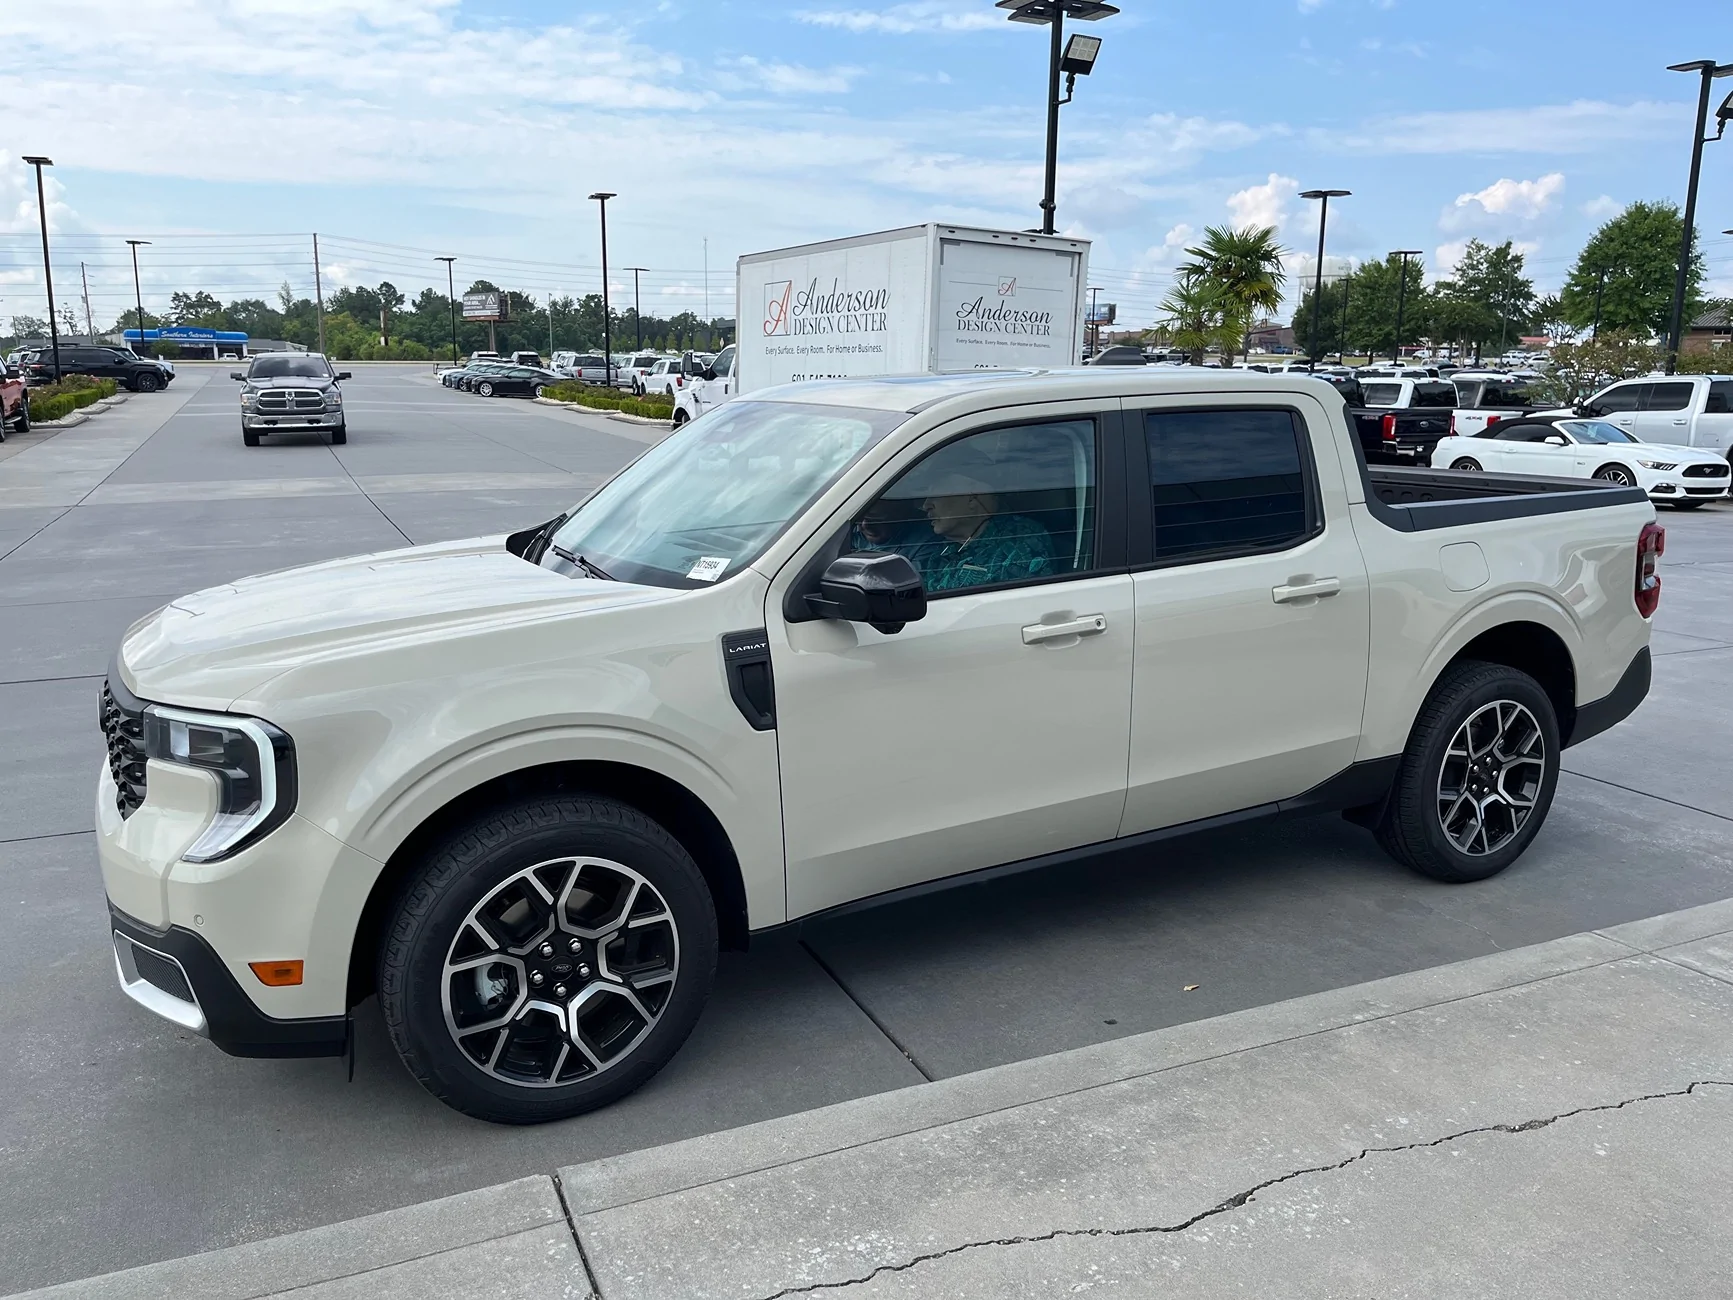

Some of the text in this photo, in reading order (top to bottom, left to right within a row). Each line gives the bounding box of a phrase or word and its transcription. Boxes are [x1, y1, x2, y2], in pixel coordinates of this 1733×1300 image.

[792, 277, 891, 316] Anderson
[956, 296, 1054, 324] Anderson
[794, 312, 887, 335] DESIGN CENTER
[957, 319, 1050, 336] DESIGN CENTER
[765, 346, 777, 356] Every
[778, 345, 795, 354] Surface.
[797, 345, 809, 356] Every
[810, 345, 825, 354] Room.
[827, 344, 835, 353] For
[835, 344, 850, 353] Home
[858, 343, 883, 353] Business.
[729, 643, 767, 653] LARIAT
